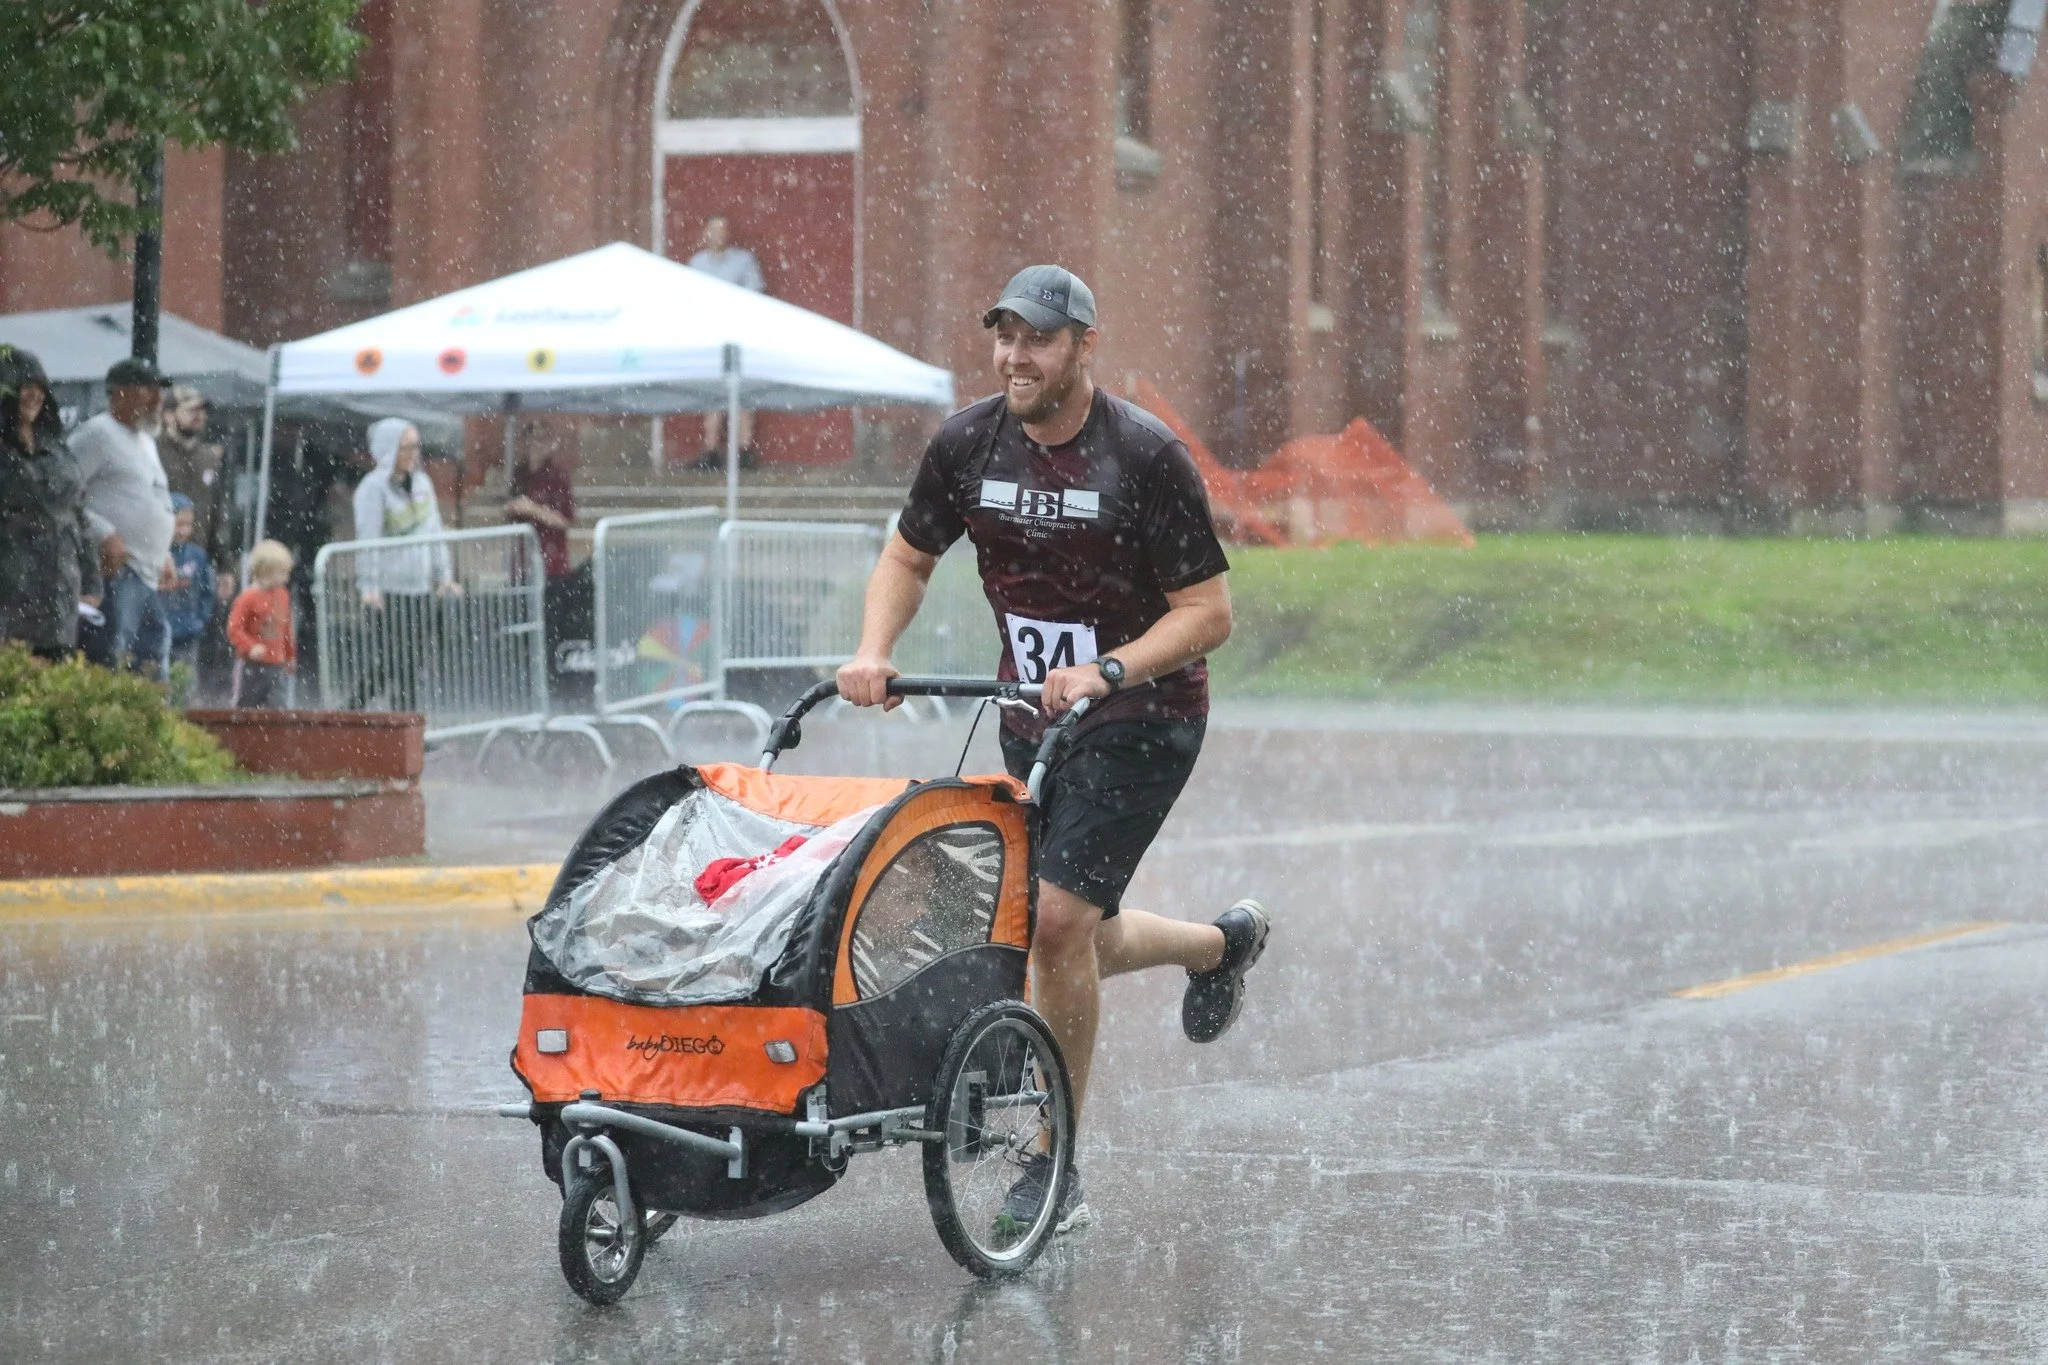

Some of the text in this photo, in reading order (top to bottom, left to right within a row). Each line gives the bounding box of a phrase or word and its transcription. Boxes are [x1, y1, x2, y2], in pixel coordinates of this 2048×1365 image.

[1026, 490, 1057, 517] B
[1026, 528, 1048, 539] Clinic
[1034, 518, 1077, 530] Chiropractic
[1017, 626, 1076, 684] 34
